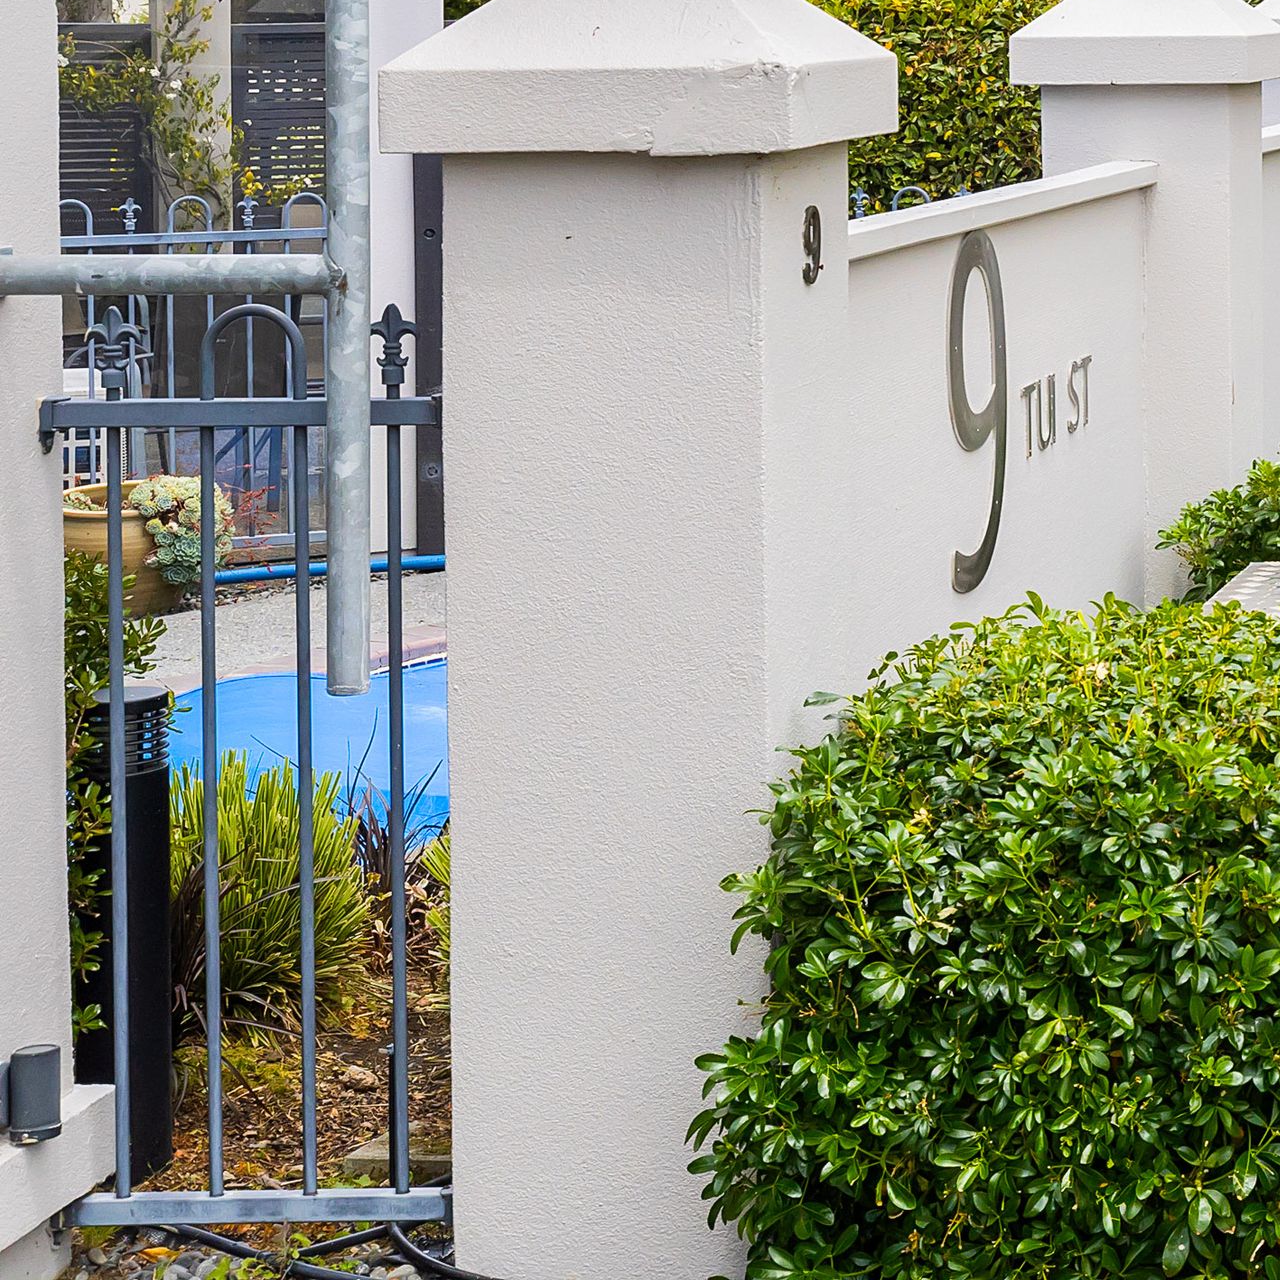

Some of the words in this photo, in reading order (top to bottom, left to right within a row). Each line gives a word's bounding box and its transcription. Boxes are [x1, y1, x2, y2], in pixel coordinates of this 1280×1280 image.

[801, 205, 822, 286] 9
[946, 229, 1008, 594] 9
[1066, 354, 1092, 433] ST
